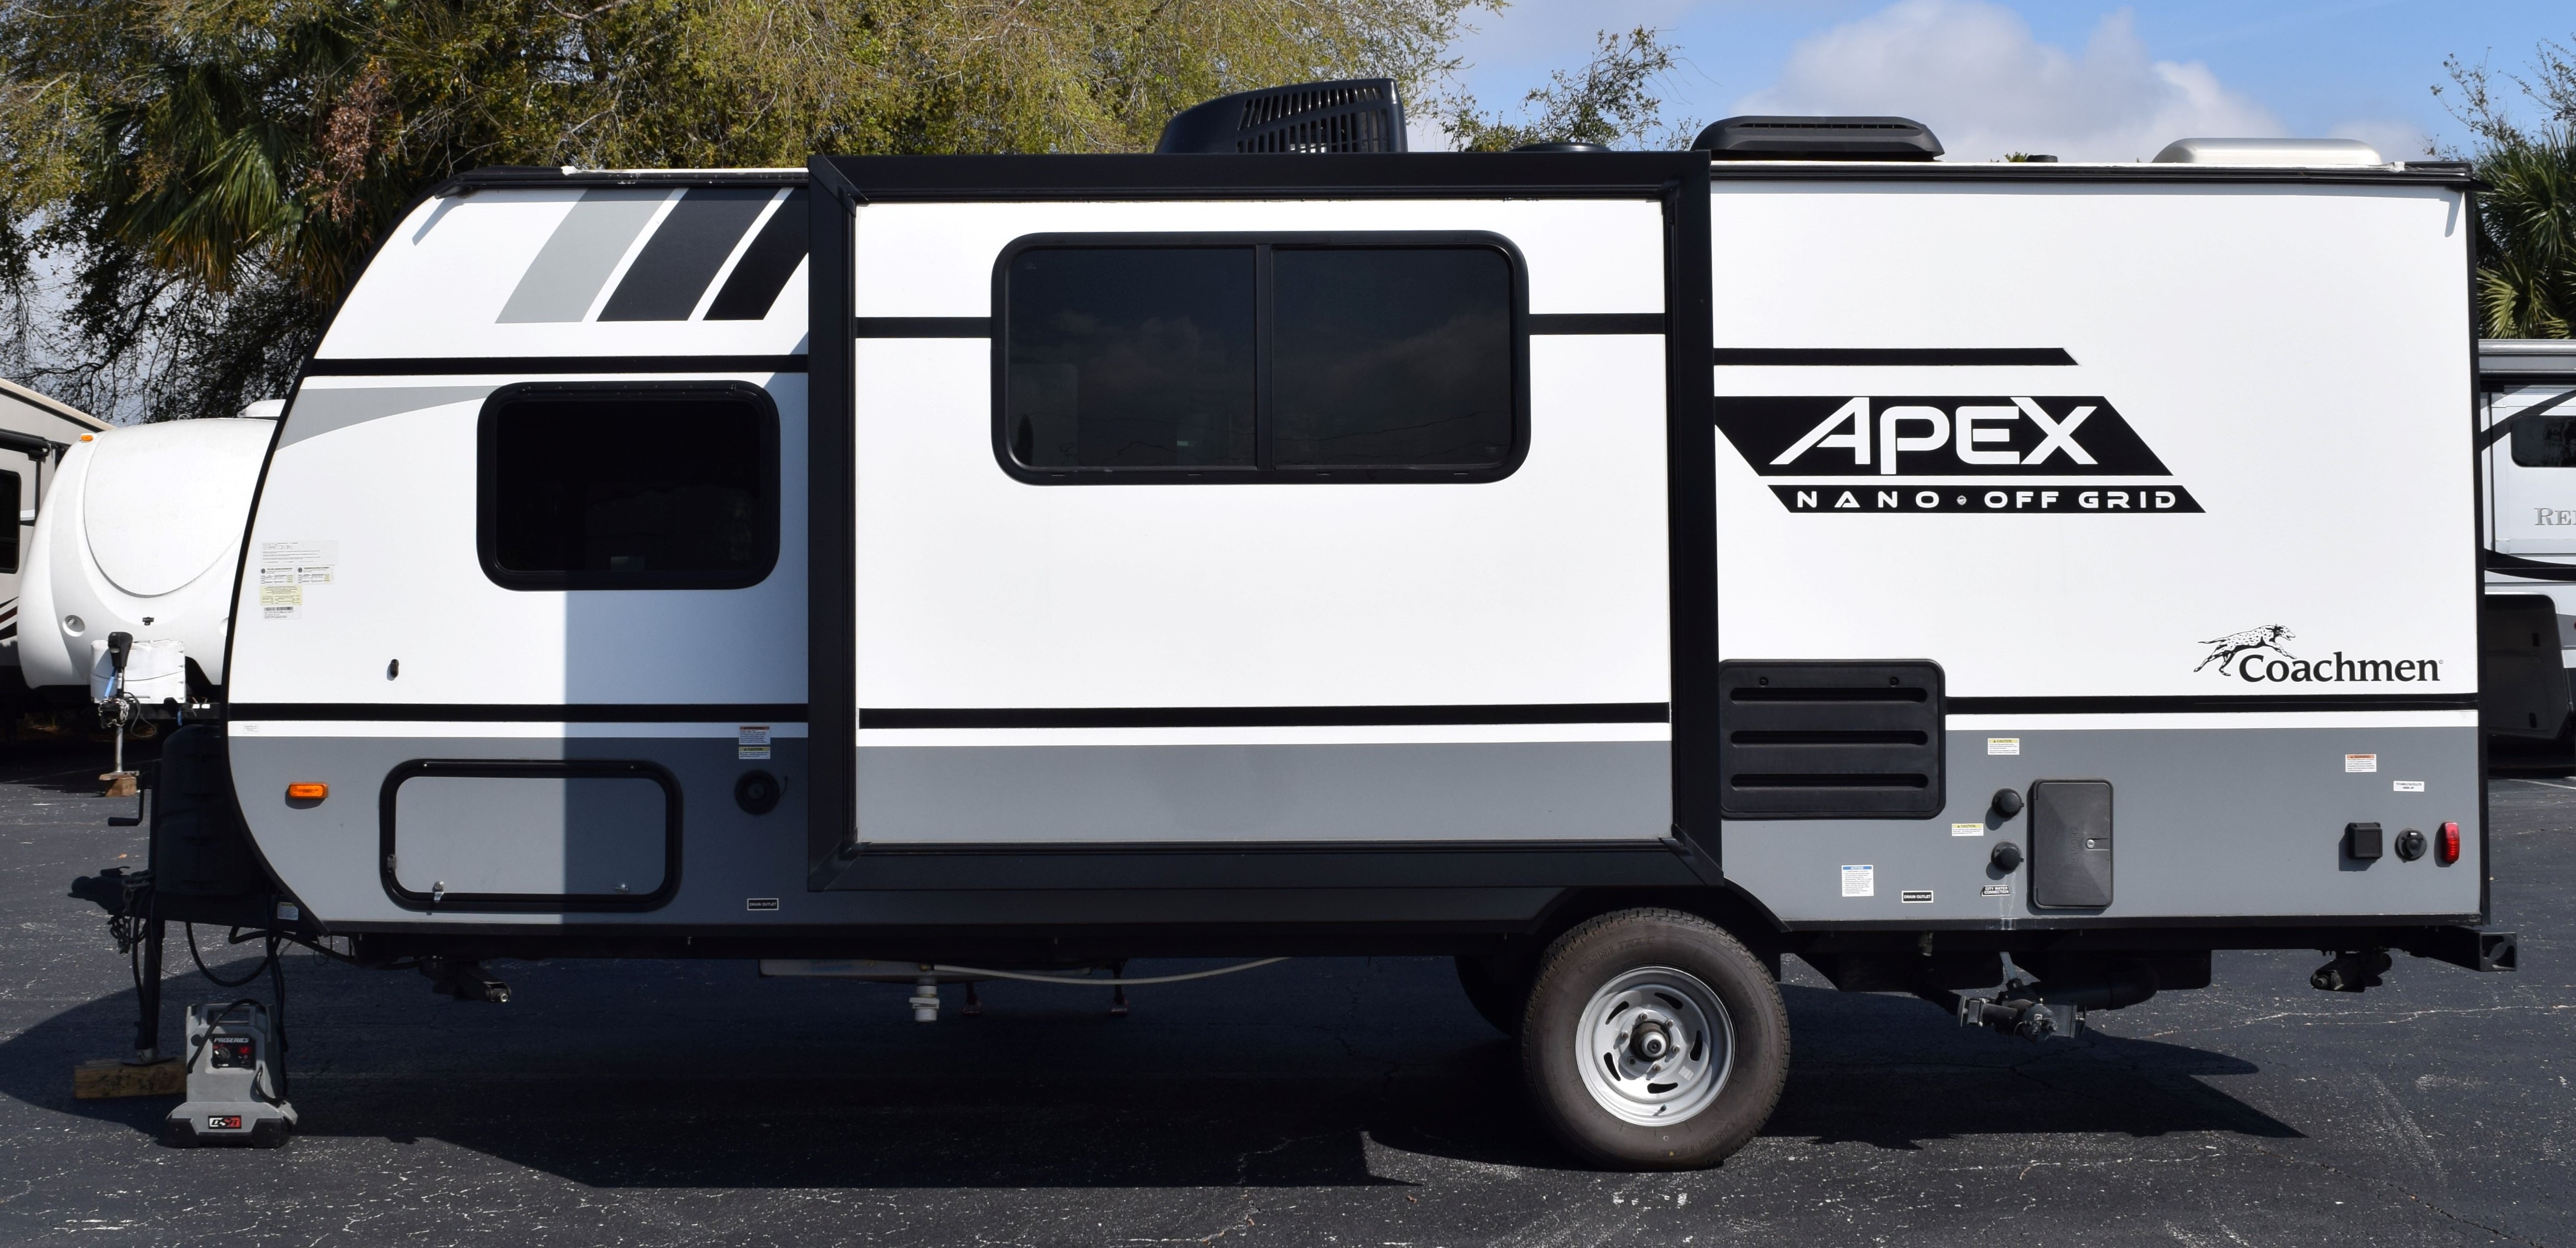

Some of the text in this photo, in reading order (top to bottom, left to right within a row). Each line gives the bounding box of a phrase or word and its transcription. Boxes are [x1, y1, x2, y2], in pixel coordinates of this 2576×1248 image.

[1769, 397, 2099, 475] APEX
[1797, 491, 2176, 508] NANO OFF GRID
[2534, 507, 2576, 526] RE
[2239, 651, 2440, 683] Coachmen
[1578, 946, 1615, 974] OMNI
